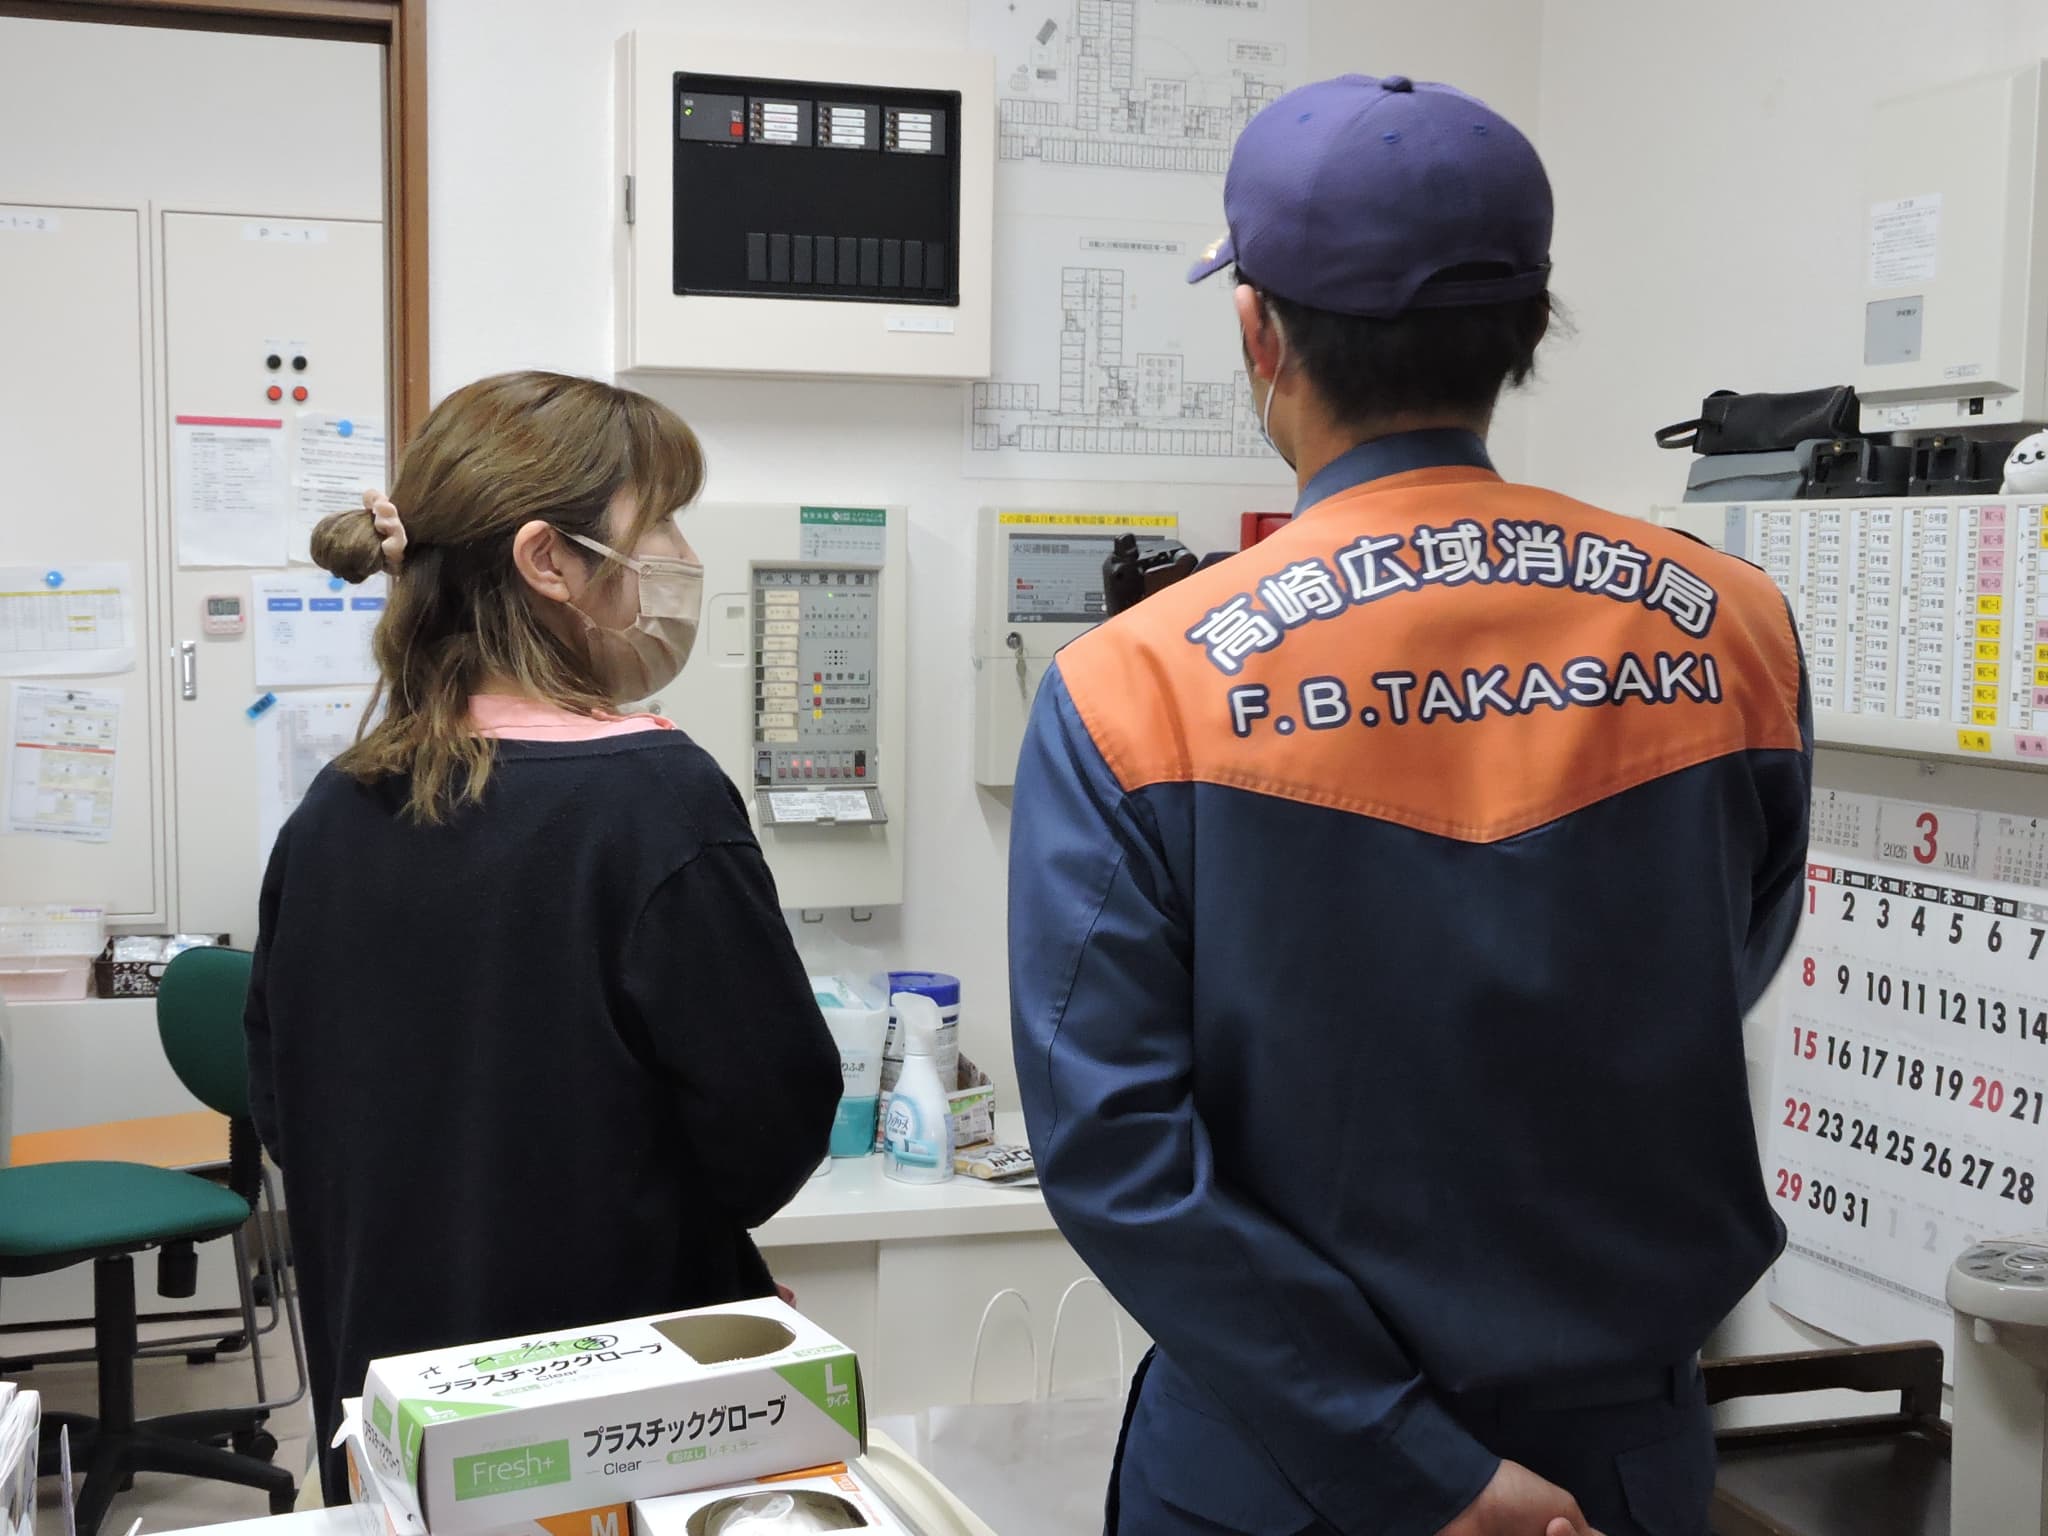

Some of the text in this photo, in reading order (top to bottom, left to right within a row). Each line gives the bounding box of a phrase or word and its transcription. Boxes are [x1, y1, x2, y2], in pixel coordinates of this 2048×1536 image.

[1188, 520, 1719, 674] 高崎広域消防局
[1229, 653, 1722, 737] F.B.TAKASAKI
[1829, 791, 1836, 801] 2
[1912, 812, 1939, 865] 3
[2030, 818, 2037, 828] 4
[1882, 842, 1908, 860] 2026
[1943, 853, 1970, 871] MAR
[1808, 885, 2046, 960] 1 2 3 4 5 6 7
[1803, 957, 2048, 1045] 8 9 10 11 12 13 14
[1793, 1026, 2043, 1125] 15 16 17 18 19 20 21
[1782, 1097, 2035, 1205] 22 23 24 25 26 27 28
[1775, 1168, 1803, 1202] 29
[1808, 1179, 1837, 1215] 30
[1843, 1192, 1869, 1228] 31
[1922, 1219, 1939, 1254] 2
[428, 1342, 663, 1395] プラスチックグローブ
[535, 1370, 580, 1382] Clear
[824, 1363, 848, 1394] L
[827, 1393, 850, 1408] サイズ
[583, 1394, 787, 1458] プラスチックグローブ
[472, 1448, 555, 1487] Fresh+
[603, 1459, 643, 1476] Clear
[590, 1511, 619, 1536] M
